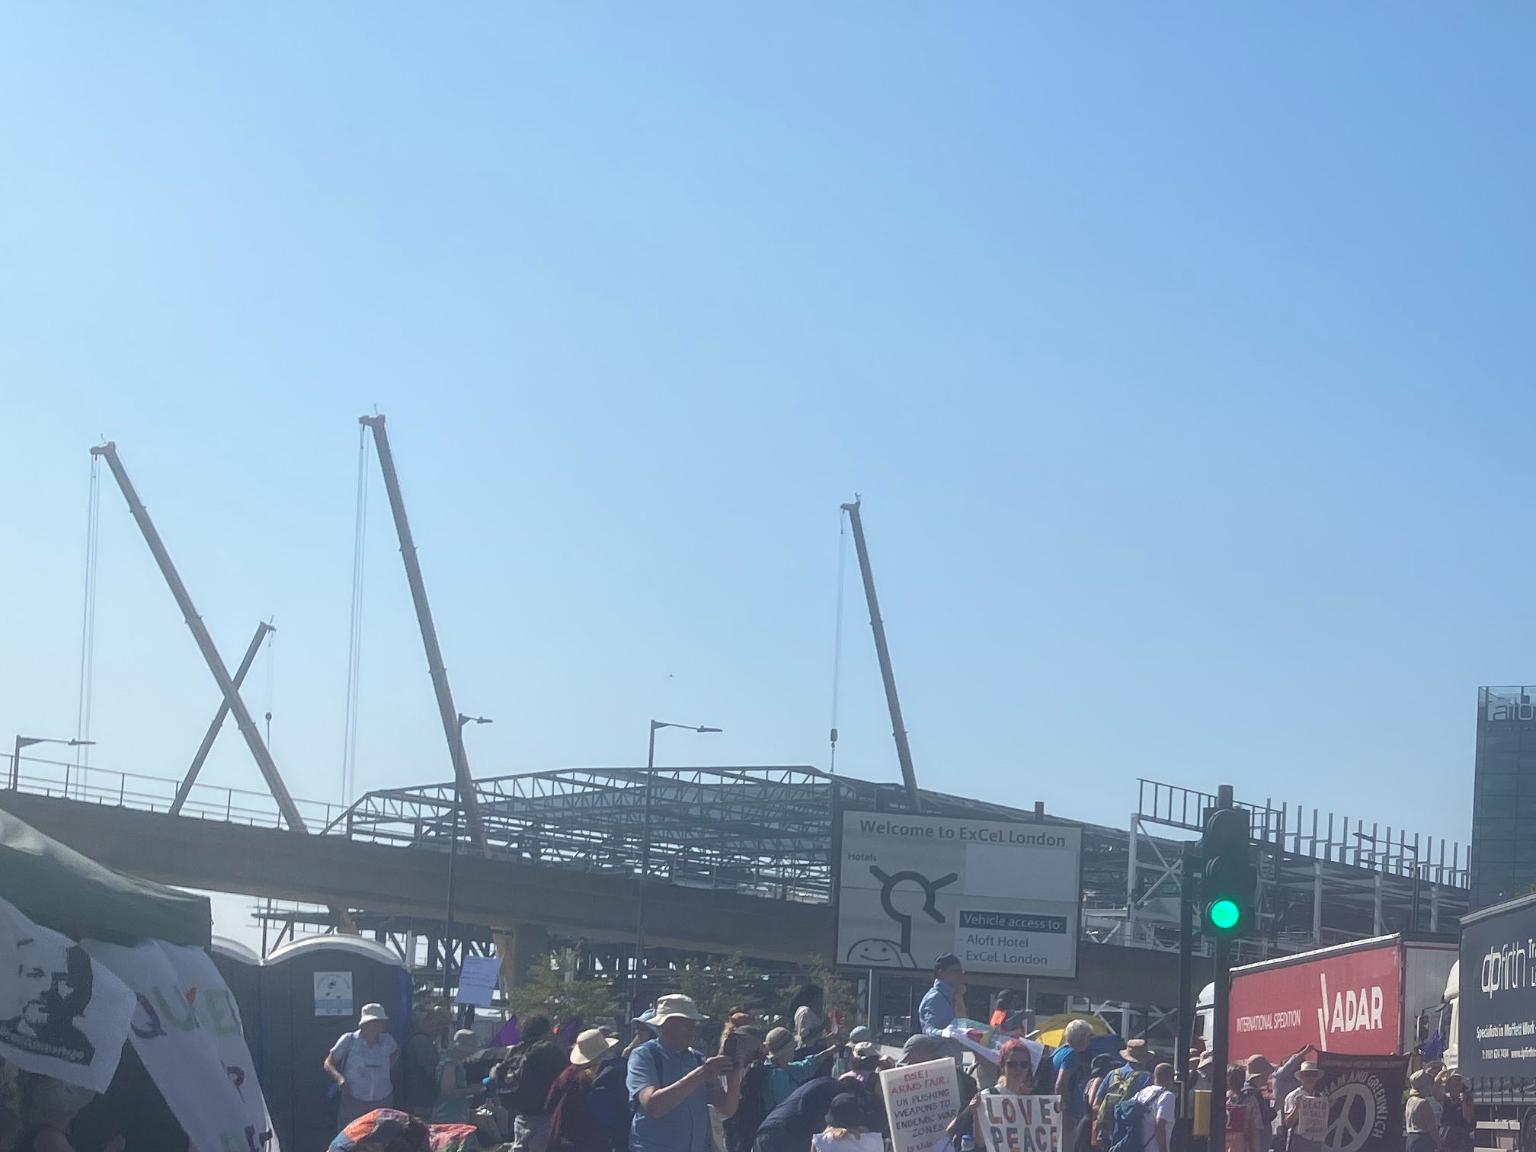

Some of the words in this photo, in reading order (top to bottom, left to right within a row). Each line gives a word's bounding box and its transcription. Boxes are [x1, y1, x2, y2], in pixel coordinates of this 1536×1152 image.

[860, 819, 934, 839] Welcome
[939, 826, 955, 840] to
[960, 828, 1005, 843] ExCeL
[1009, 832, 1066, 848] London
[848, 852, 877, 863] Hotels
[963, 912, 1005, 927] Vehicle
[1008, 918, 1047, 930] access
[966, 934, 994, 947] Aloft
[998, 936, 1029, 948] Hotel
[1004, 953, 1048, 966] London
[1481, 942, 1526, 999] dpfirth
[1236, 1014, 1273, 1033] INTERNATIONAL
[1273, 1009, 1301, 1029] SPEDITION
[894, 1102, 938, 1119] WEAPONS
[940, 1099, 951, 1109] TO
[896, 1098, 908, 1107] UK
[986, 1097, 1051, 1125] LOVE
